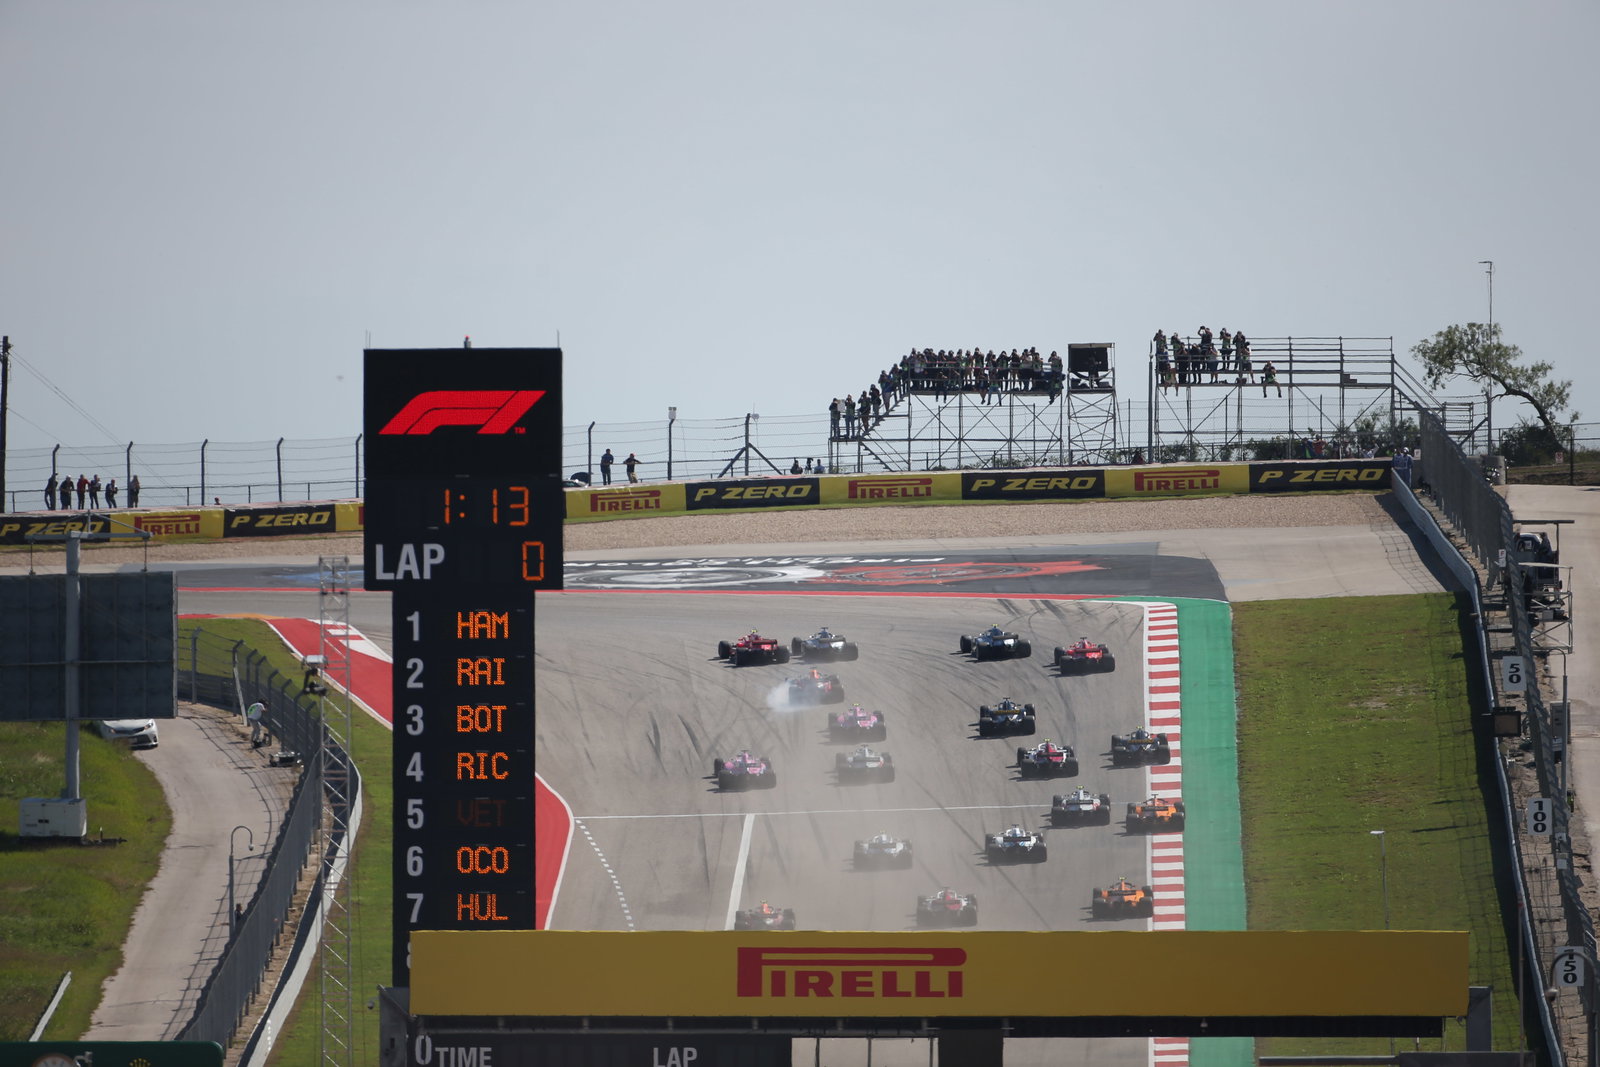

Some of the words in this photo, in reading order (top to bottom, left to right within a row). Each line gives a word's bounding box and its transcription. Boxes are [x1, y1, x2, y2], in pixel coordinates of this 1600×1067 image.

[970, 479, 997, 491] P
[1002, 477, 1097, 490] ZERO
[1134, 470, 1220, 491] PIRELLI
[1258, 470, 1284, 483] P
[1290, 468, 1385, 482] ZERO
[694, 488, 713, 501] P
[722, 485, 813, 500] ZERO
[848, 478, 933, 499] PIRELLI
[590, 489, 661, 512] PIRELLI
[0, 523, 21, 537] P
[25, 521, 104, 537] ZERO
[135, 514, 200, 535] PIRELLI
[231, 515, 250, 528] P
[255, 511, 331, 527] ZERO
[375, 543, 445, 580] LAP
[522, 541, 545, 581] 0
[407, 611, 420, 642] 1
[457, 611, 509, 639] HAM
[406, 658, 424, 689] 2
[457, 658, 505, 686] RAI
[406, 705, 424, 736] 3
[457, 705, 507, 733] BOT
[406, 752, 424, 782] 4
[457, 752, 509, 780] RIC
[407, 799, 424, 829] 5
[457, 799, 507, 827] VET
[406, 846, 424, 877] 6
[457, 847, 509, 874] OCO
[406, 893, 424, 923] 7
[457, 894, 509, 921] HUL
[737, 947, 967, 997] PIRELLI
[435, 1047, 492, 1067] TIME
[653, 1047, 698, 1067] LAP
